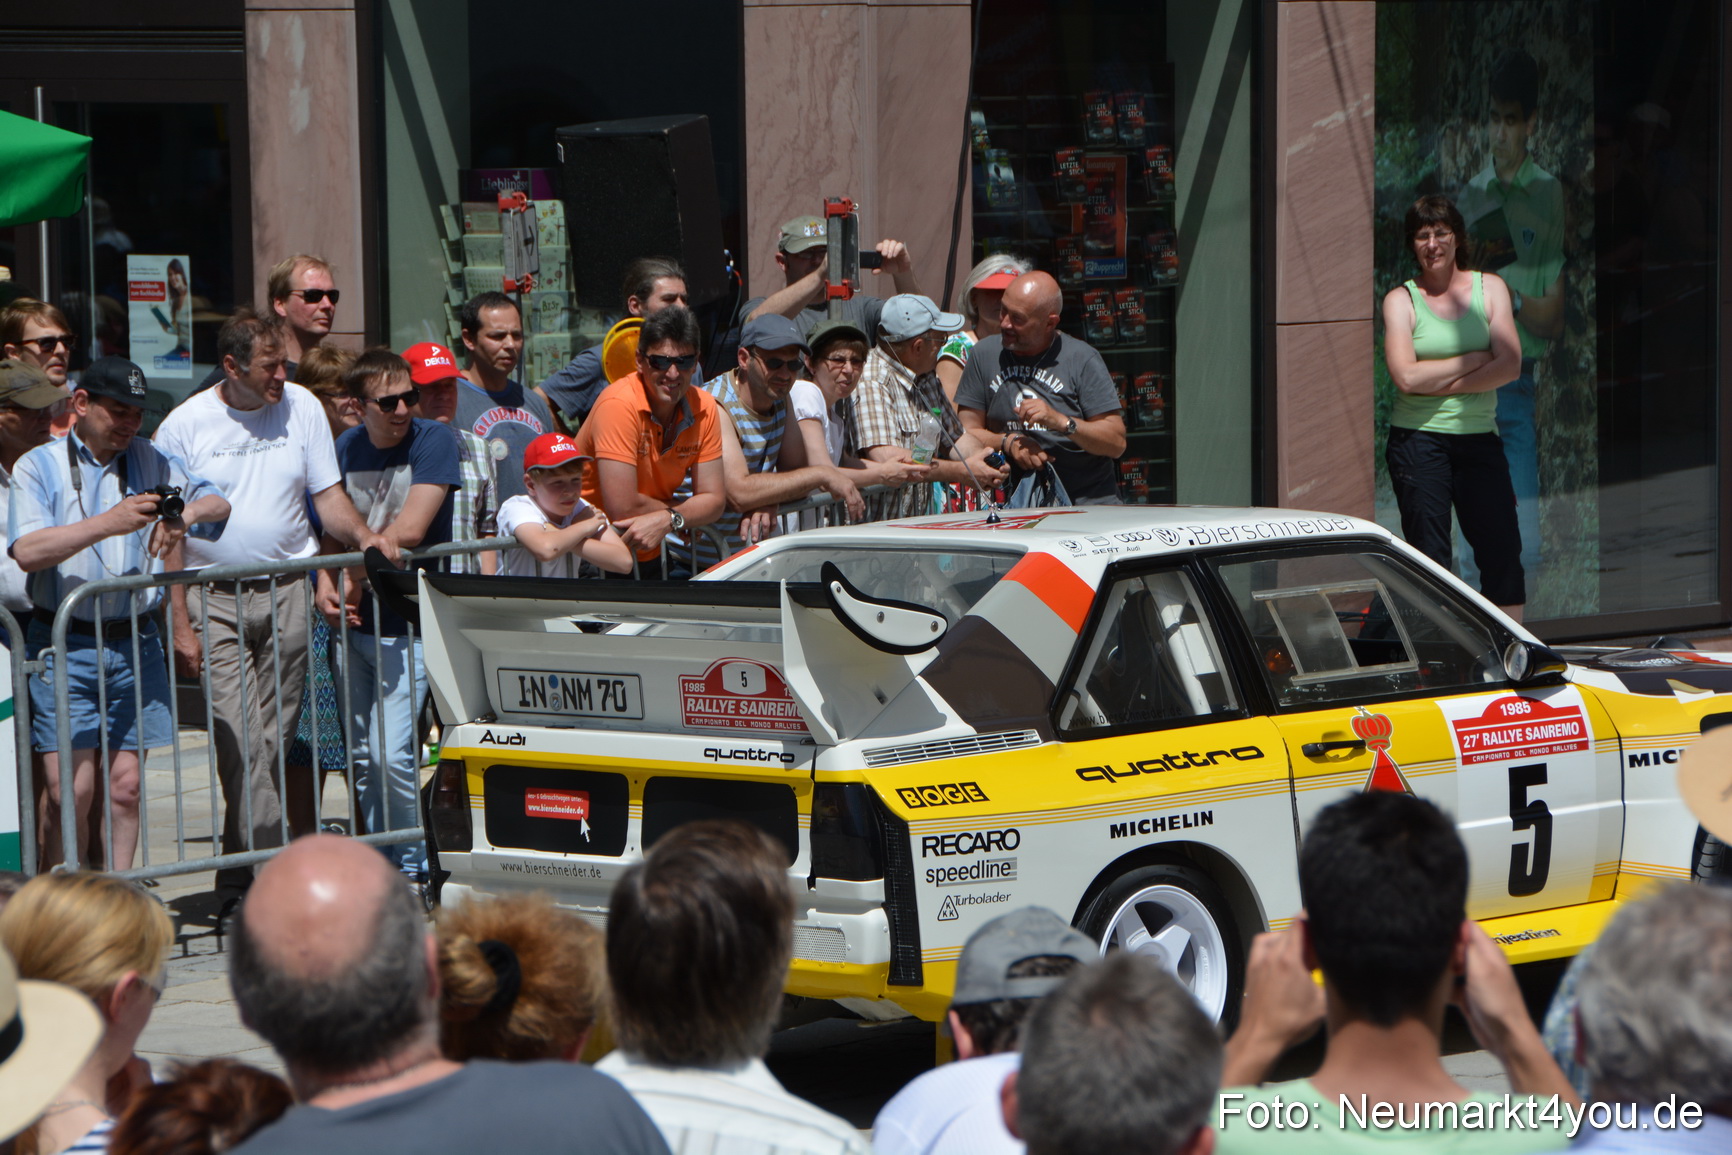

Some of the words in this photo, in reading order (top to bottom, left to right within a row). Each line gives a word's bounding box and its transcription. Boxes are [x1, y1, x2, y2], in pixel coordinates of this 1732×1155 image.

[1088, 103, 1106, 111] LETZTE
[1097, 110, 1112, 118] STICH
[1118, 104, 1137, 112] LETZTE
[1128, 110, 1143, 118] STICH
[1060, 162, 1079, 170] LETZTE
[1150, 160, 1167, 168] LETZTE
[1158, 166, 1172, 174] STICH
[1068, 168, 1084, 176] STICH
[1094, 206, 1113, 215] STICH
[1059, 248, 1077, 256] LETZTE
[1152, 244, 1170, 252] LETZTE
[1094, 260, 1124, 274] Rupprecht
[1087, 303, 1105, 311] LETZTE
[1119, 301, 1138, 309] LETZTE
[424, 356, 450, 367] DEKRA
[1032, 367, 1064, 394] ISLAND
[1137, 386, 1156, 394] LETZTE
[474, 407, 541, 436] GLORIOUS
[551, 442, 576, 453] DEKRA
[1190, 517, 1356, 545] Bierschneider
[1092, 547, 1120, 555] SEAT
[741, 671, 748, 688] 5
[518, 676, 547, 708] IN
[562, 678, 593, 710] NM
[597, 680, 628, 713] 70
[684, 683, 705, 693] 1985
[687, 698, 736, 714] RALLYE
[1500, 702, 1531, 716] 1985
[1070, 705, 1182, 726] www.bierschneider.de
[691, 718, 730, 726] CAMPIONATO
[774, 722, 801, 730] RALLYES
[479, 730, 526, 746] Audi
[1482, 728, 1523, 746] RALLYE
[1525, 721, 1579, 741] SANREMO
[703, 748, 795, 763] quattro
[1472, 752, 1510, 762] CAMPIONATO
[1514, 750, 1526, 758] DEL
[1530, 747, 1549, 755] MONDO
[1552, 743, 1577, 753] RALLYES
[1628, 749, 1685, 768] MIC
[1076, 745, 1264, 783] quattro
[540, 794, 570, 802] Gebrauchtwagen
[900, 784, 986, 808] BOGE
[528, 804, 584, 814] www.bierschneider.de
[1110, 810, 1214, 839] MICHELIN
[1508, 763, 1553, 897] 5
[922, 828, 1021, 858] RECARO
[500, 861, 601, 878] www.bierschneider.de
[925, 858, 1011, 887] speedline
[954, 892, 1011, 907] Turbolader
